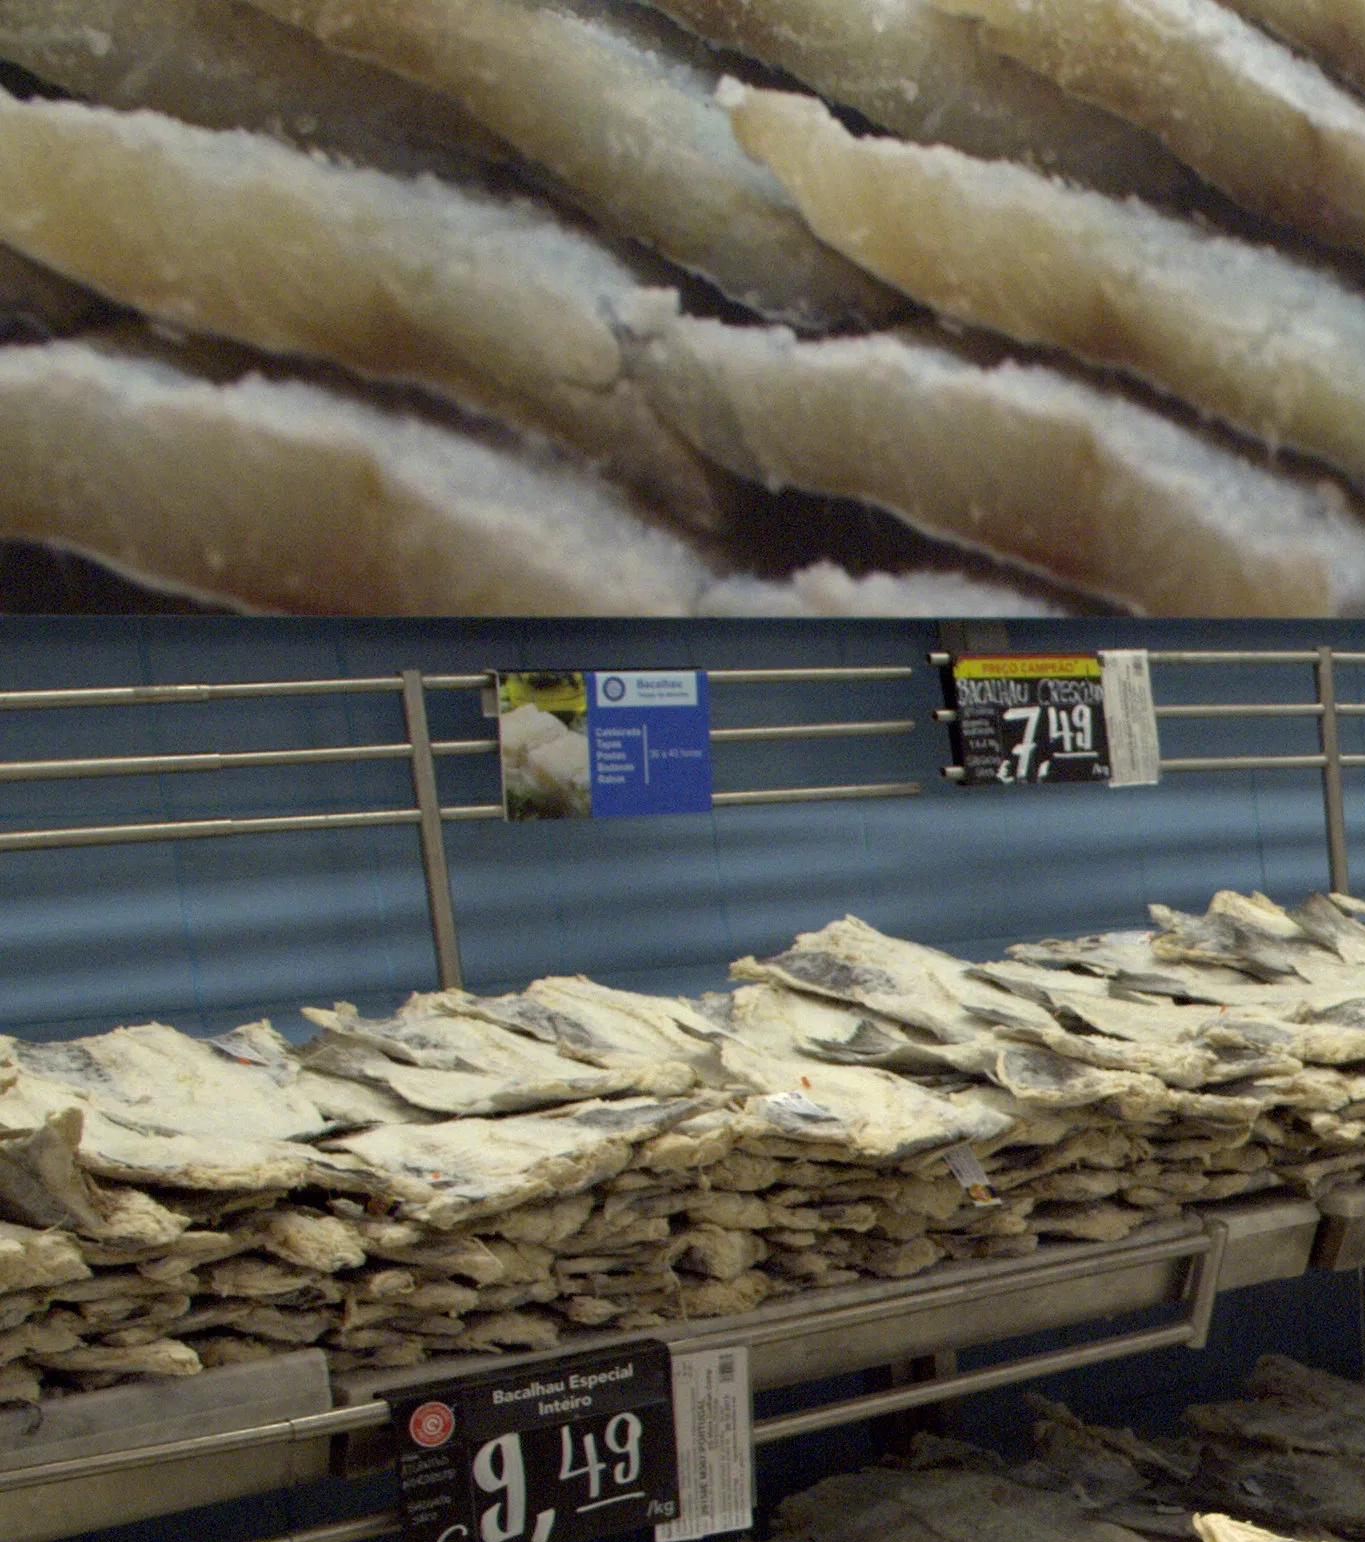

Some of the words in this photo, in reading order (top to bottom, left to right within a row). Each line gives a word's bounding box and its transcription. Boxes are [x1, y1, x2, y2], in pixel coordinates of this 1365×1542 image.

[493, 1374, 564, 1405] Bacalhau
[569, 1364, 634, 1391] Especial
[538, 1394, 592, 1416] Inteiro
